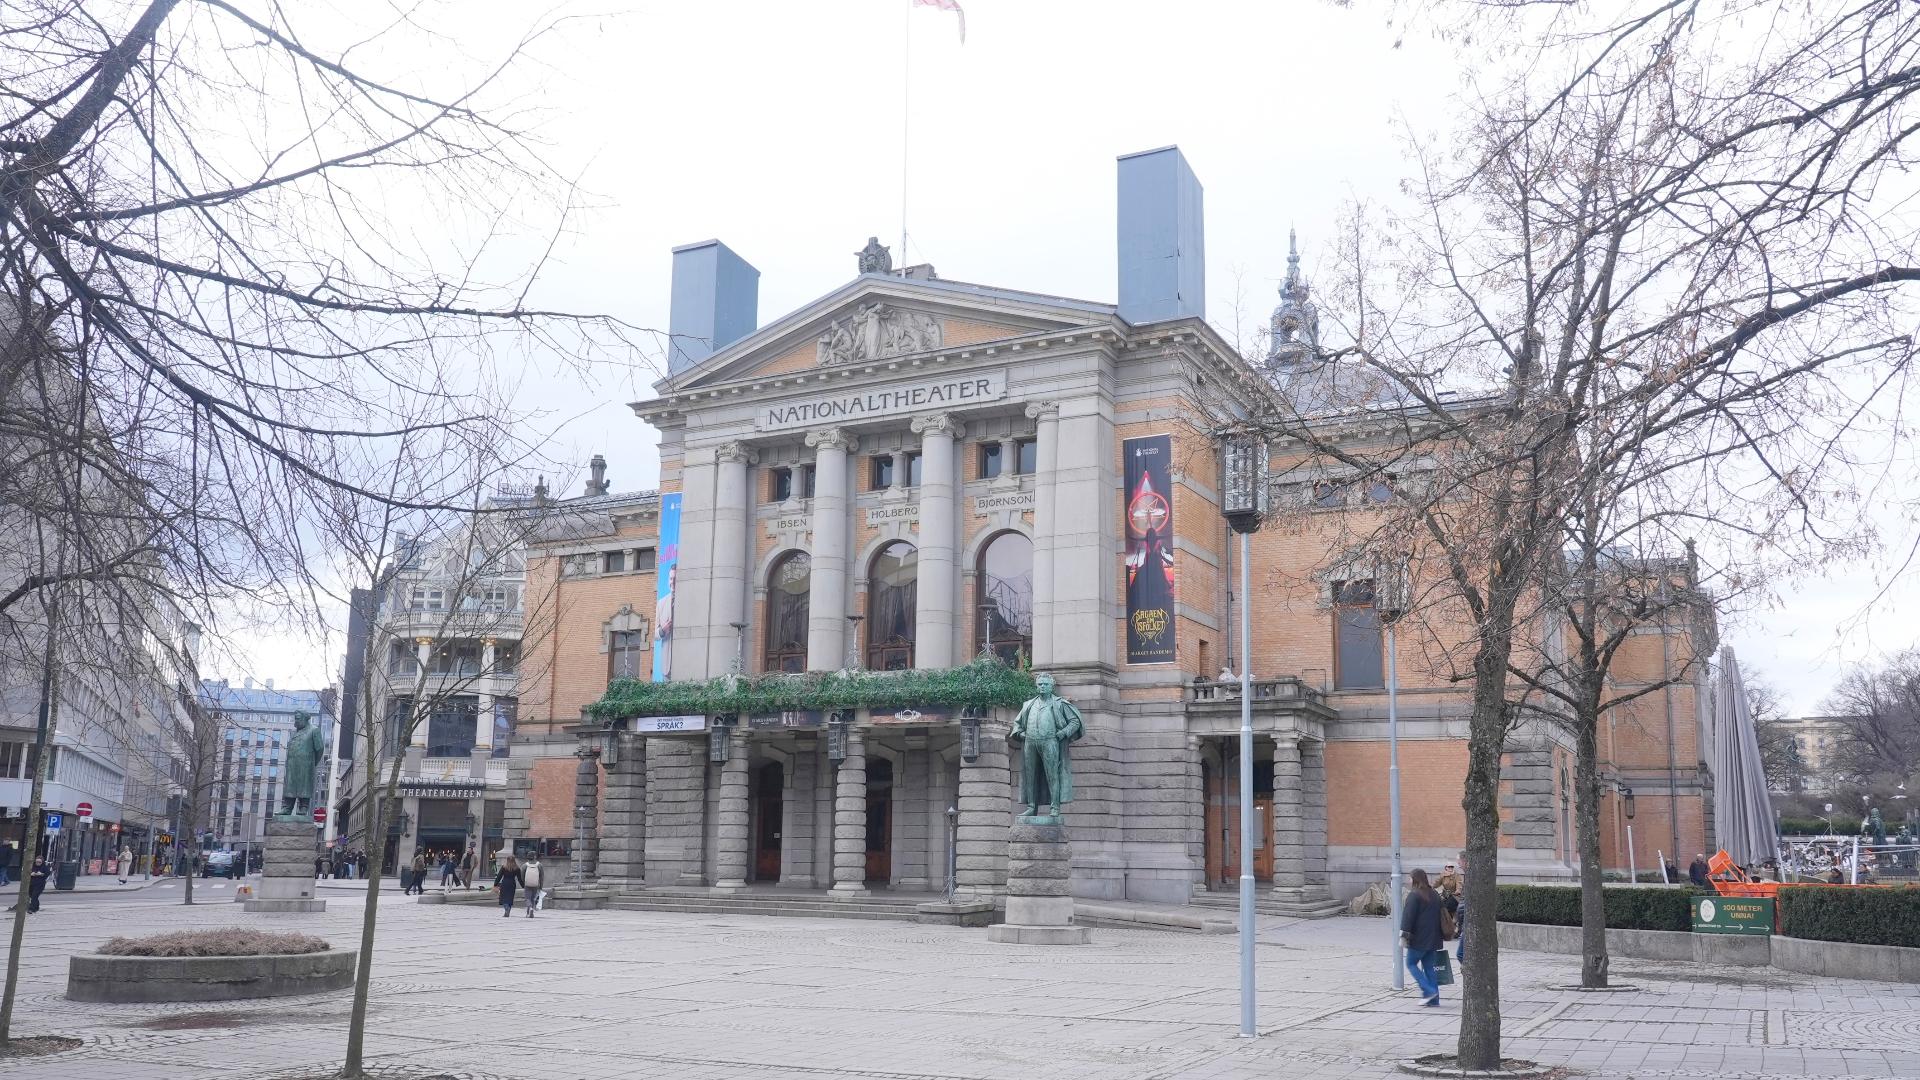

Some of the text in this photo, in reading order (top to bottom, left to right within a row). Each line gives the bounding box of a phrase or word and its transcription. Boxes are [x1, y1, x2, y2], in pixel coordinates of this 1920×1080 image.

[768, 379, 992, 425] NATIONALTHEATER
[871, 508, 918, 520] HOLBERG
[777, 518, 807, 529] IBSEN
[657, 721, 684, 730] SPRÅK?
[402, 788, 482, 798] THEATERCAFEEN
[50, 816, 58, 827] P
